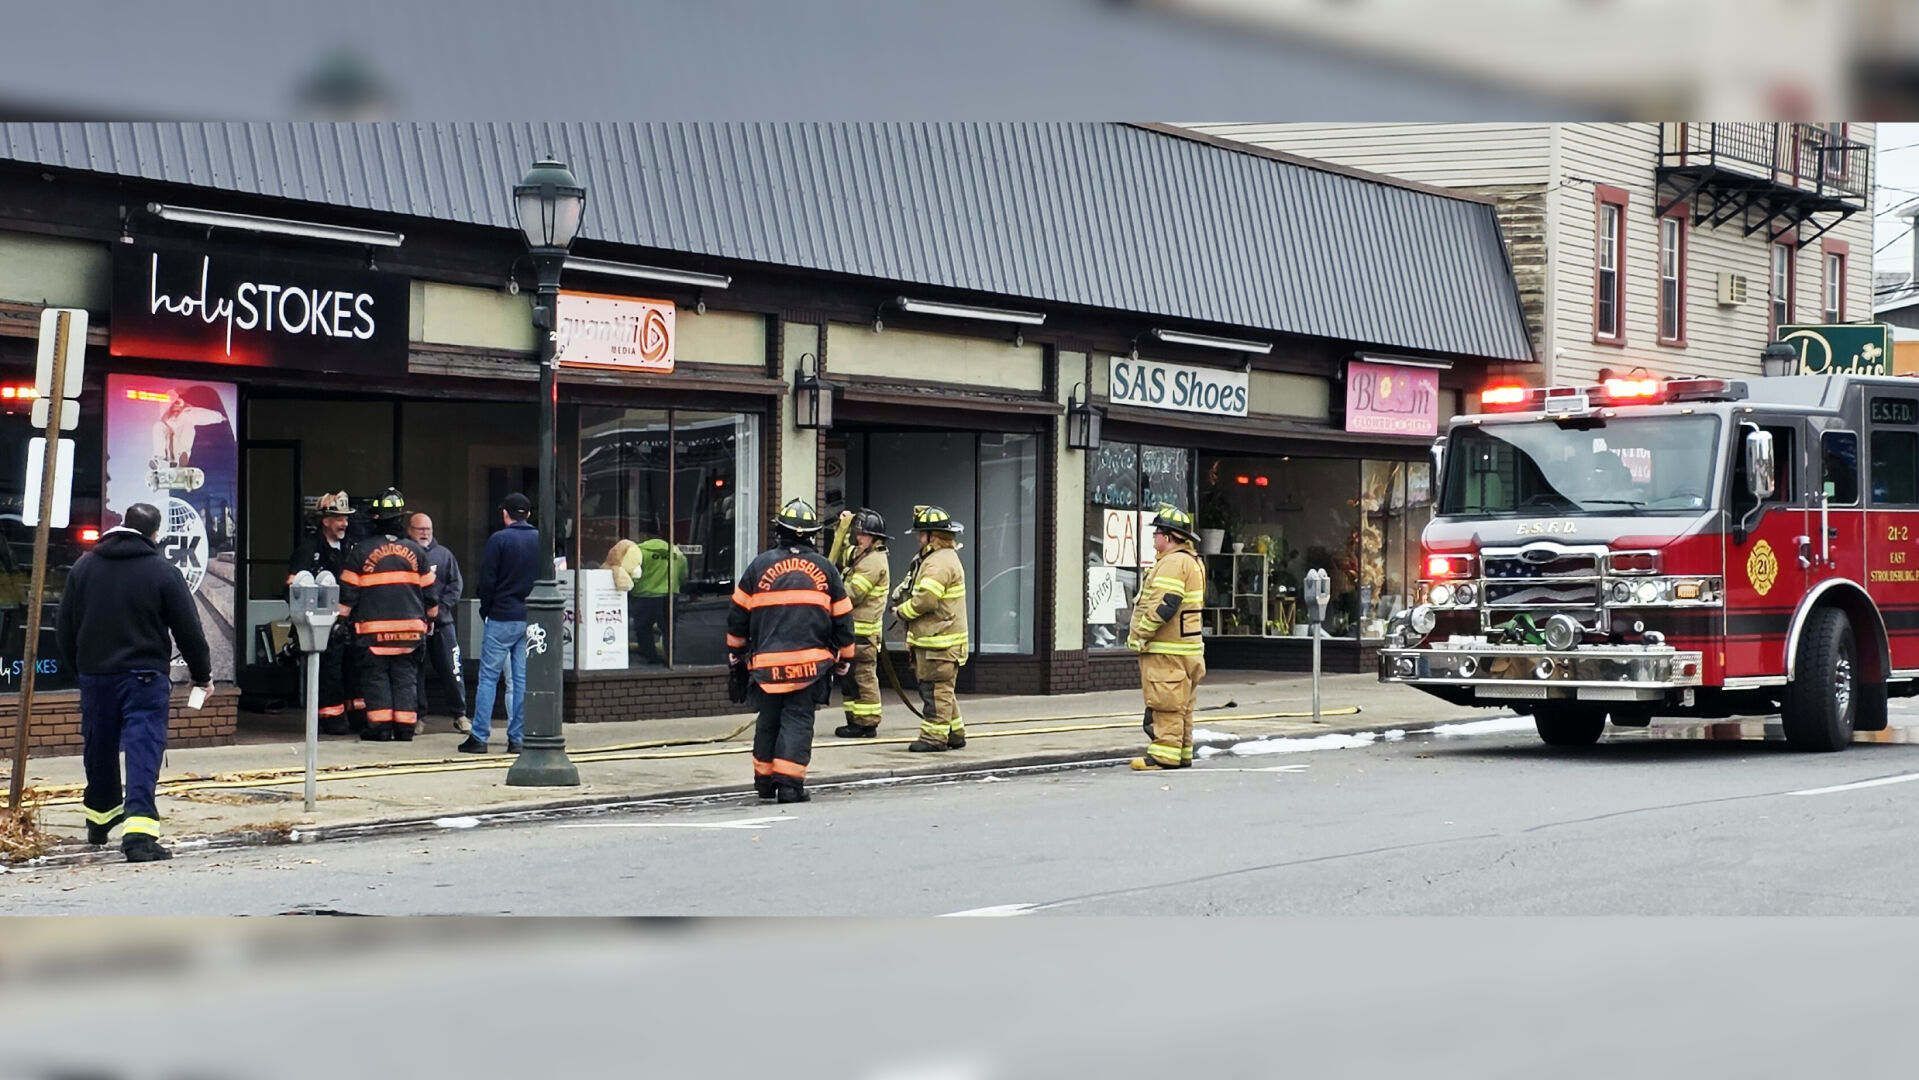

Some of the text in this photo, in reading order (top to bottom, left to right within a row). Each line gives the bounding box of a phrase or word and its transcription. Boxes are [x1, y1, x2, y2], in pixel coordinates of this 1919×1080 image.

[611, 346, 636, 355] MEDIA
[1113, 362, 1246, 412] SAS Shoes
[1872, 403, 1912, 420] E.S.F.D.
[1105, 512, 1155, 565] SAL
[1888, 526, 1908, 541] 21-2
[1890, 552, 1906, 564] EAST
[758, 558, 829, 591] STROUDSBURG
[1757, 560, 1767, 575] 21
[772, 663, 817, 680] R. SMITH
